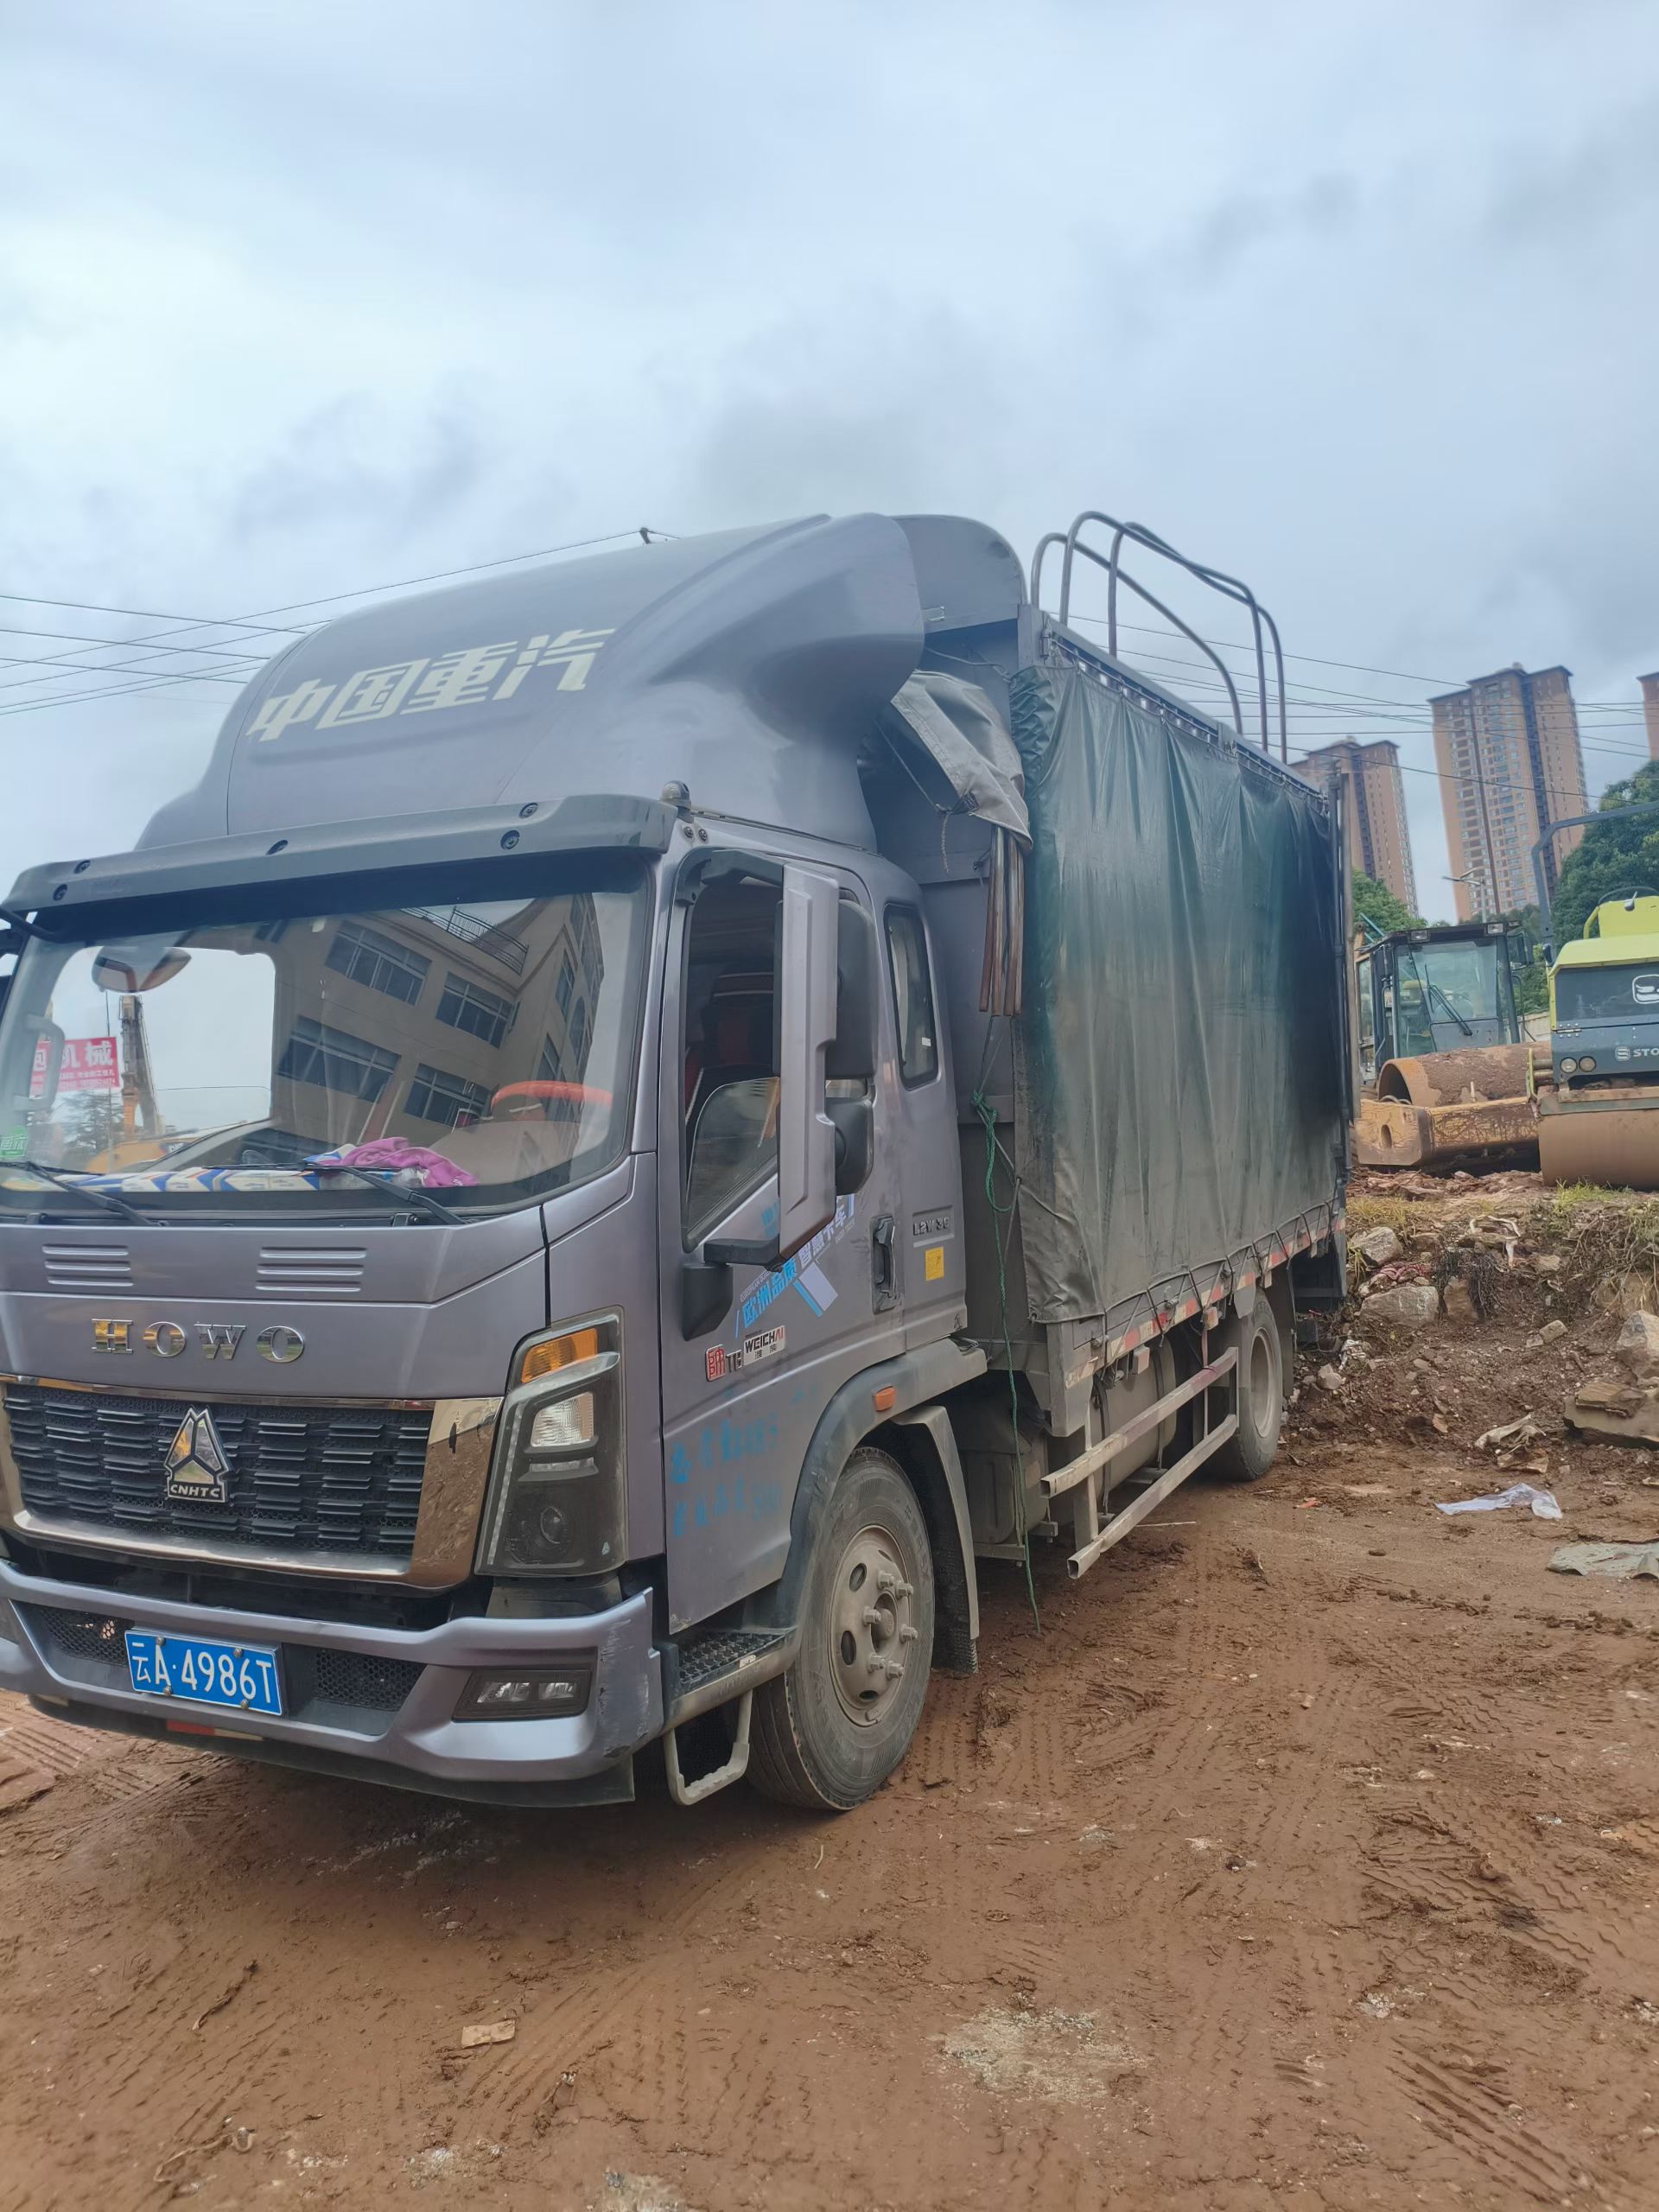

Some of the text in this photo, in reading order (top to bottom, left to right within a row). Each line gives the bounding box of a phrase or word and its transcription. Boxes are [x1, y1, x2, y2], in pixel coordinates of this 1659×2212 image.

[246, 629, 615, 742] 中国重汽
[91, 1318, 305, 1363] HOWO
[170, 1484, 220, 1497] CNHTC
